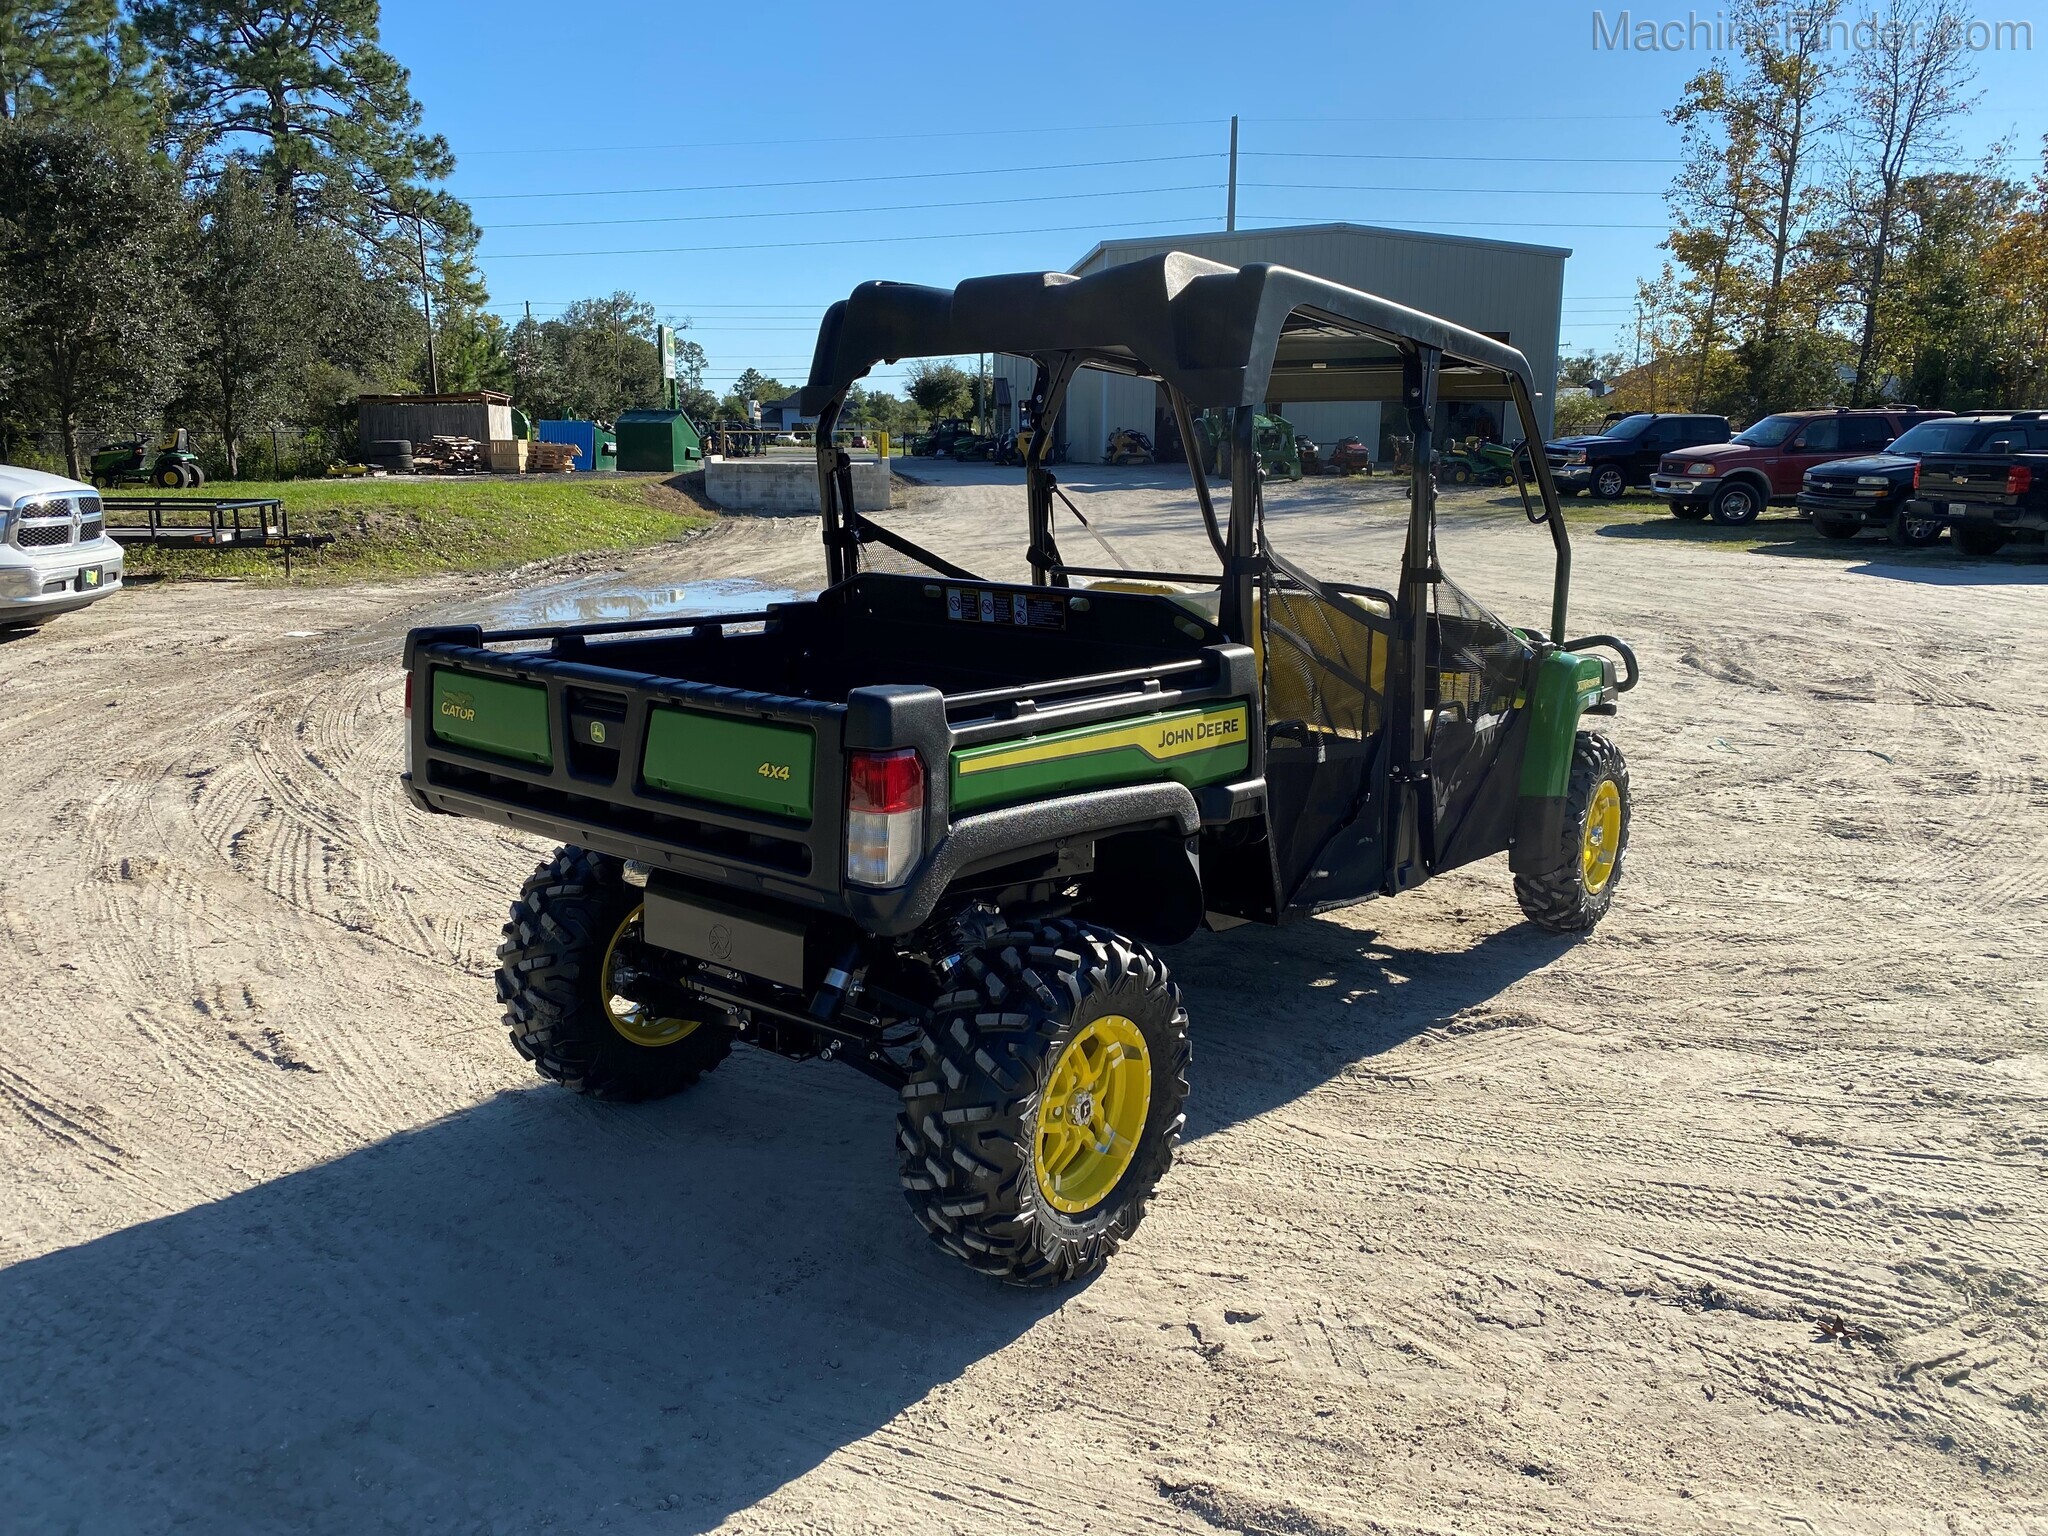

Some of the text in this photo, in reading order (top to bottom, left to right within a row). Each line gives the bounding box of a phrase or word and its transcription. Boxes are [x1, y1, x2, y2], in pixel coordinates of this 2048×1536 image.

[441, 702, 475, 721] GATOR
[1158, 718, 1239, 748] JOHN DEERE
